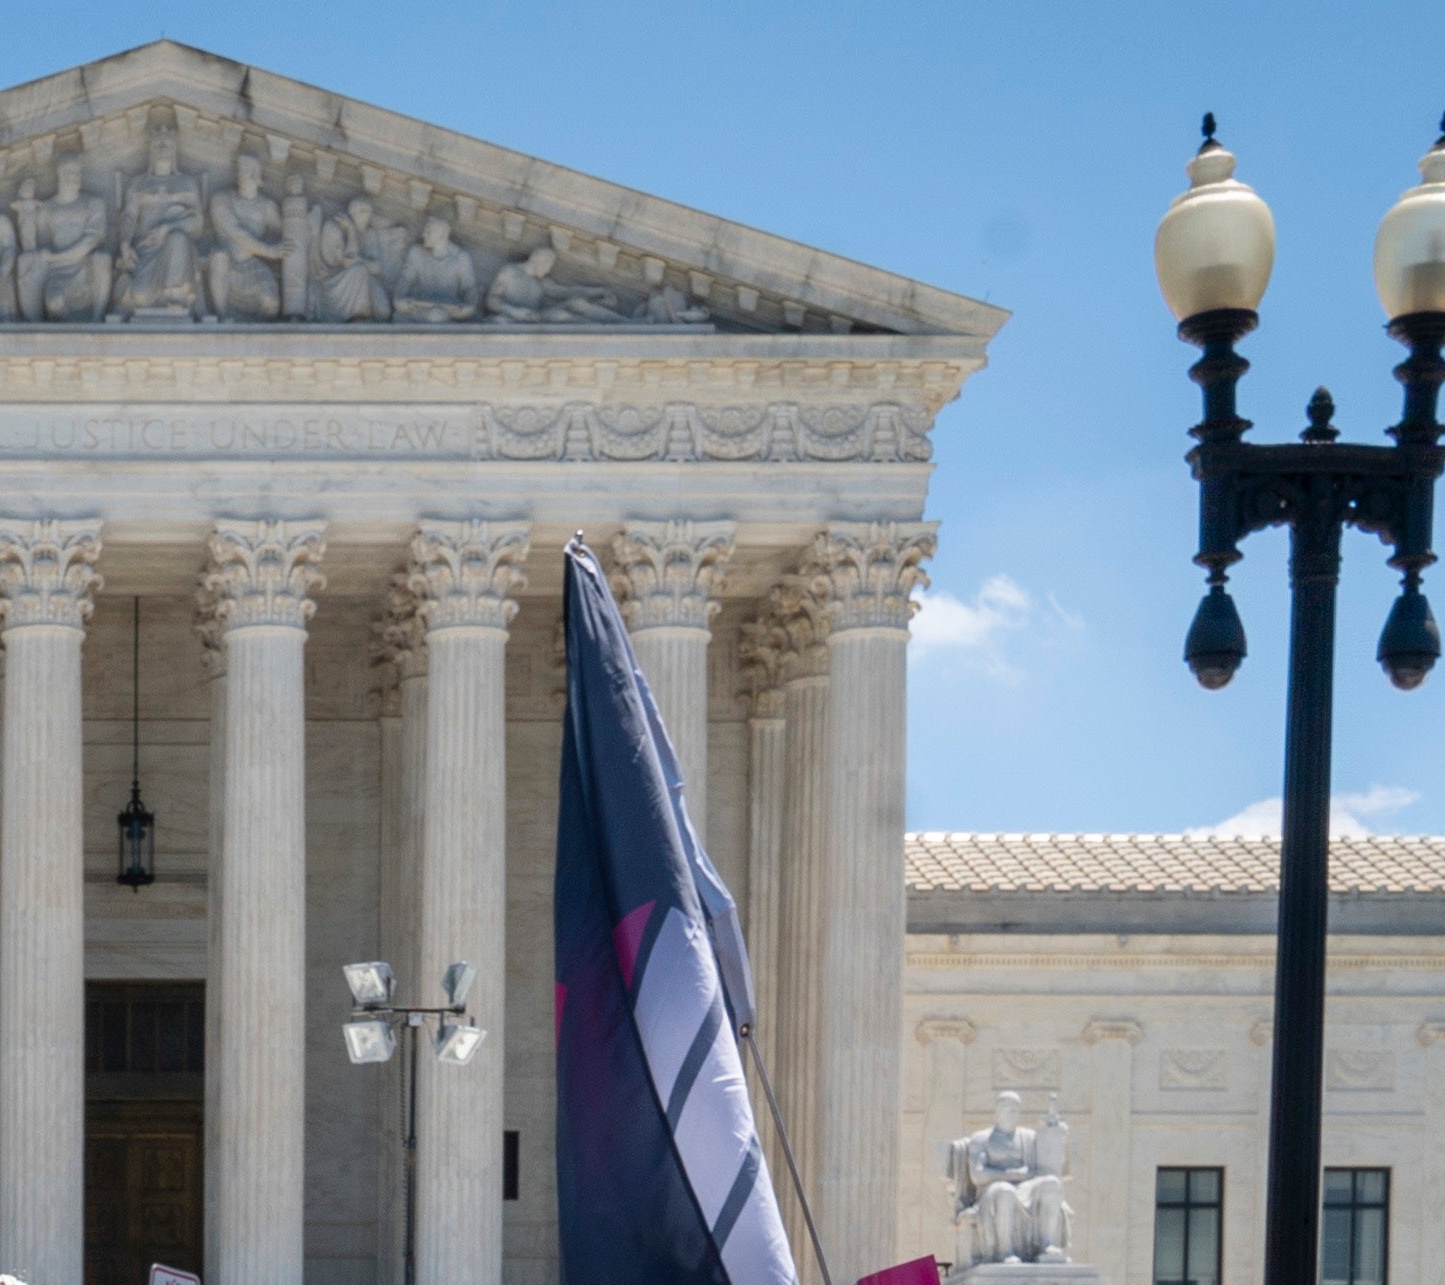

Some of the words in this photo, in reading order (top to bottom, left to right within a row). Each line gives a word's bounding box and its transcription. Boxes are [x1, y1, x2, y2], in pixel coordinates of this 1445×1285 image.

[17, 417, 189, 452] JUSTICE
[208, 418, 351, 452] UNDER
[368, 418, 448, 451] LAW
